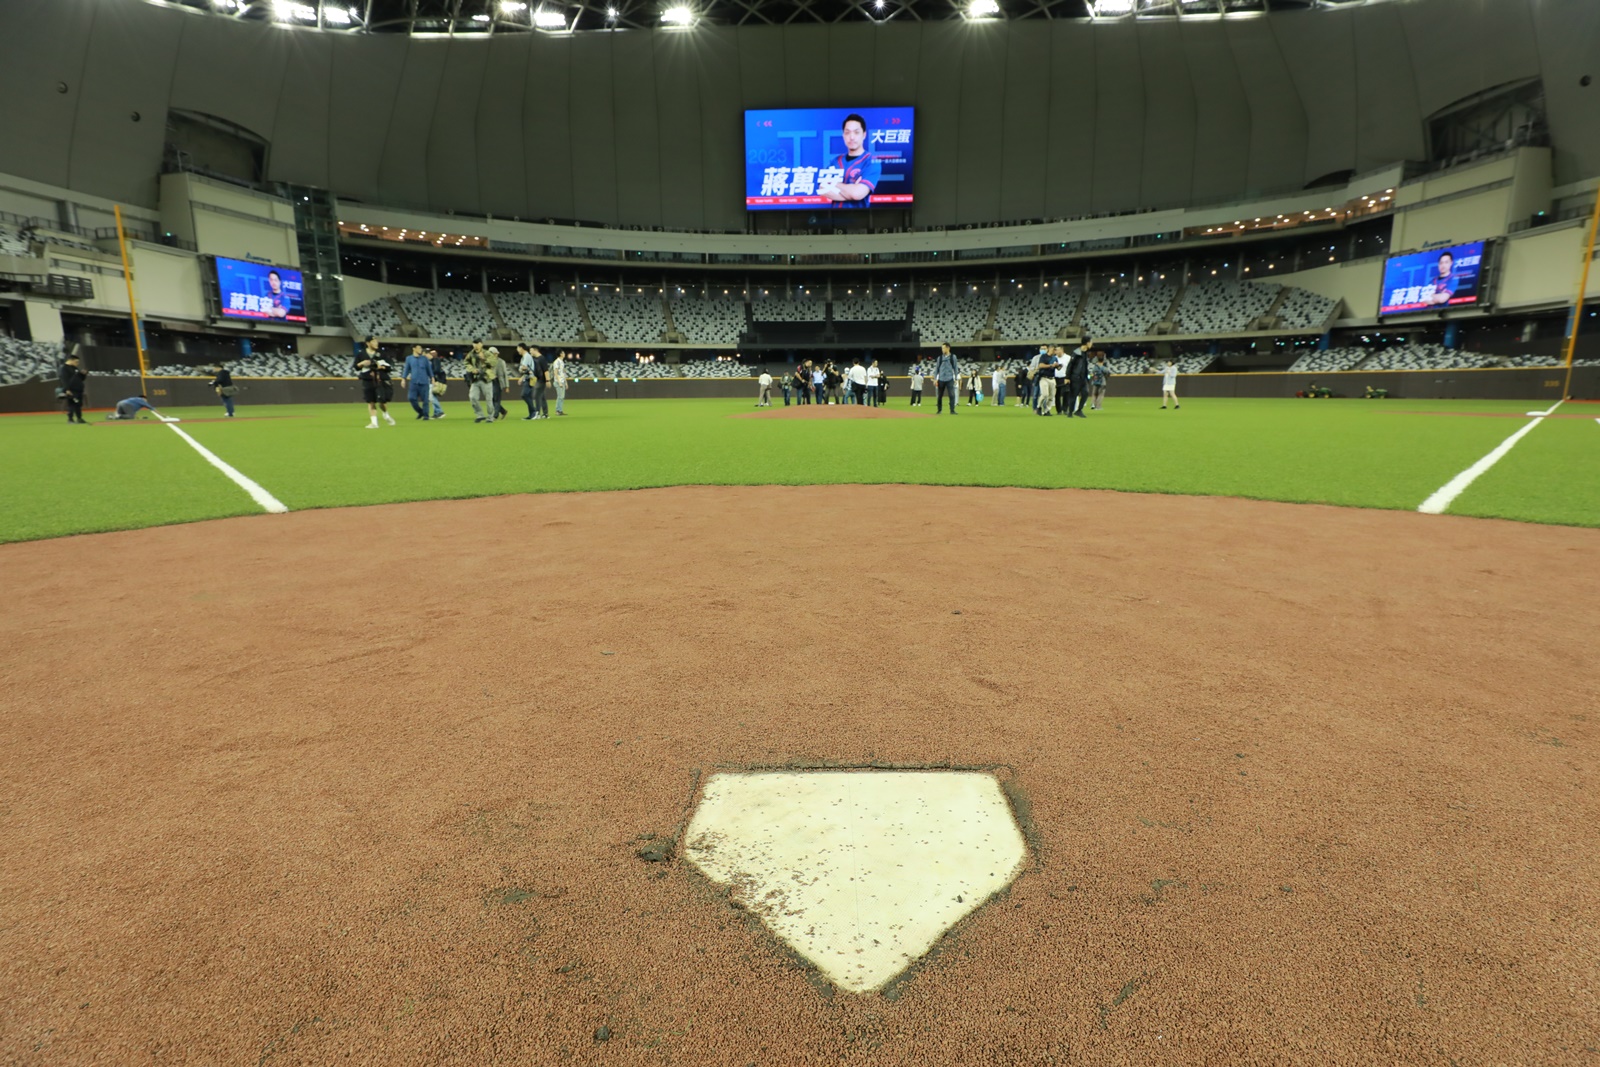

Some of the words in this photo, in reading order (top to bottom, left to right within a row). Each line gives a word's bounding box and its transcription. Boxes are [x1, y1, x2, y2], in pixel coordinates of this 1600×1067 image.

[870, 129, 912, 144] 大巨蛋
[748, 148, 787, 164] 2023
[760, 165, 845, 197] 蔣萬安
[229, 292, 274, 313] 蔣萬安
[1388, 283, 1438, 306] 蔣萬安
